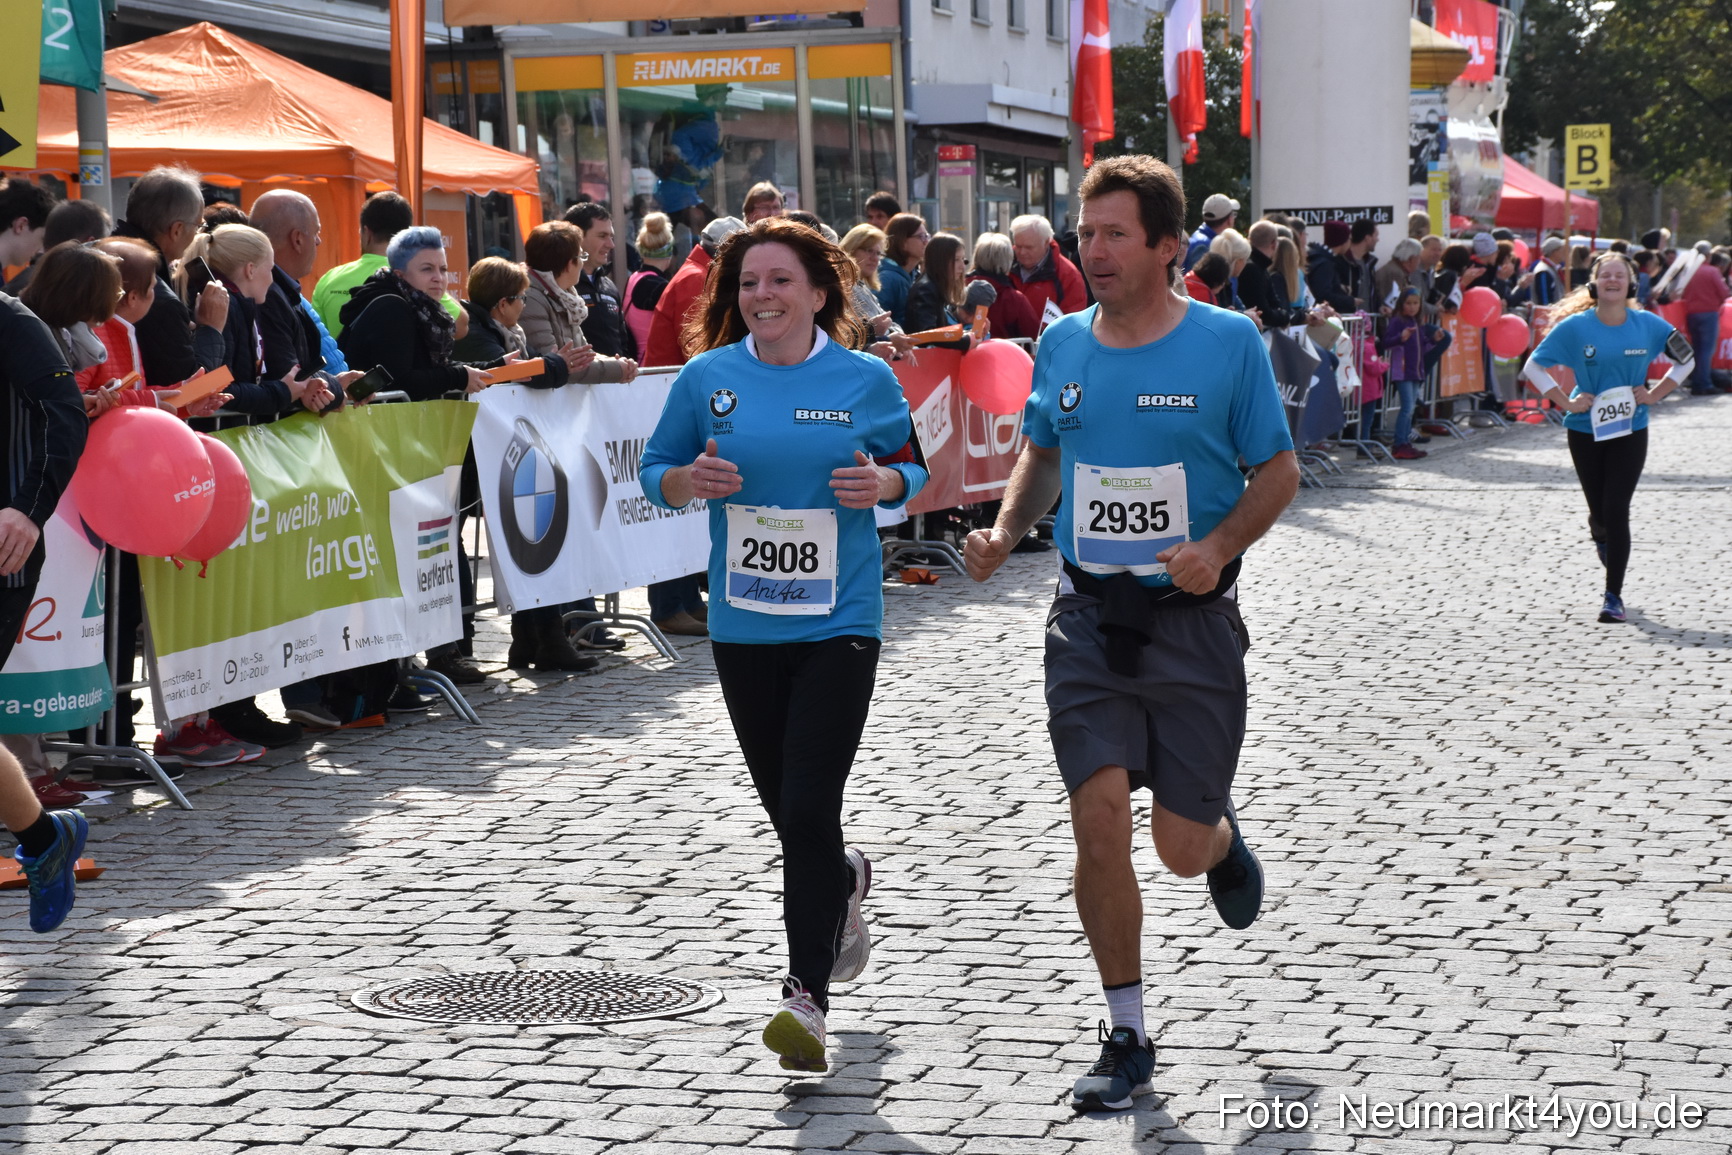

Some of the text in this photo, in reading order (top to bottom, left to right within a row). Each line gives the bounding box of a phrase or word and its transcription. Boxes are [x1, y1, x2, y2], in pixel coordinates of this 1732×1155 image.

[44, 7, 74, 51] 2
[633, 56, 781, 80] RUNMARKT.DE
[1571, 127, 1605, 140] Block
[1577, 144, 1599, 175] B
[1137, 395, 1197, 407] BOCK
[795, 408, 852, 423] BOCK
[1598, 401, 1632, 422] 2945
[713, 421, 734, 430] PARTL
[1058, 417, 1081, 426] PARTL
[1112, 477, 1152, 488] BOCK
[276, 491, 322, 535] weiß,
[327, 491, 350, 520] wo
[616, 496, 656, 526] WENIGER
[1089, 500, 1170, 534] 2935
[767, 517, 804, 529] BOCK
[742, 537, 819, 574] 2908
[742, 577, 811, 604] Anita
[82, 624, 94, 638] Jura
[197, 669, 202, 680] 1
[190, 684, 198, 696] d.
